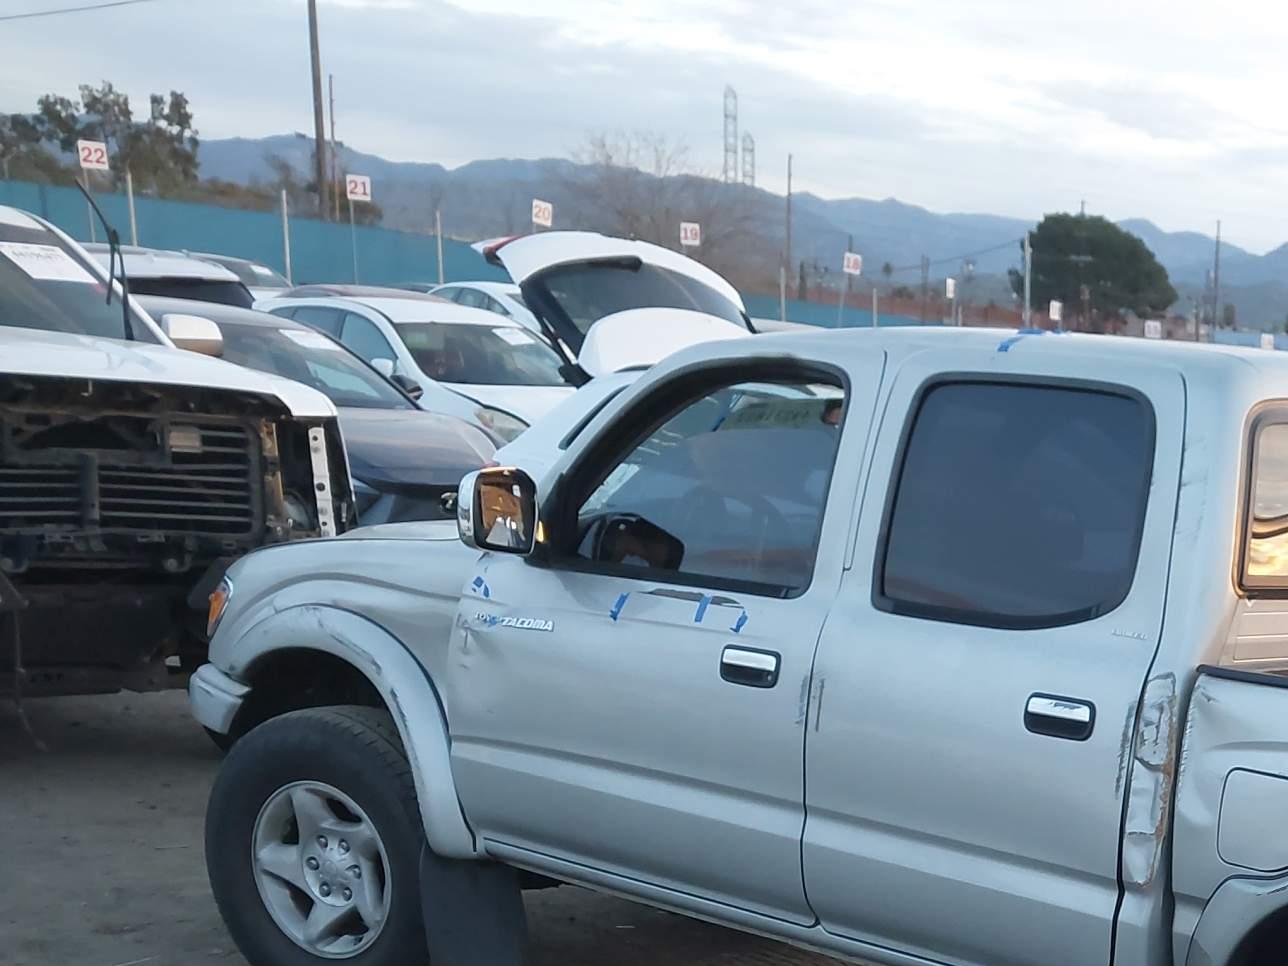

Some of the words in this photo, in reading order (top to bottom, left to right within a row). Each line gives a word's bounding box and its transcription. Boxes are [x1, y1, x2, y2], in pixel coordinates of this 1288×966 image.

[81, 146, 106, 165] 22
[348, 179, 369, 197] 21
[534, 204, 551, 220] 20
[682, 226, 699, 241] 19
[500, 616, 555, 632] TACOMA
